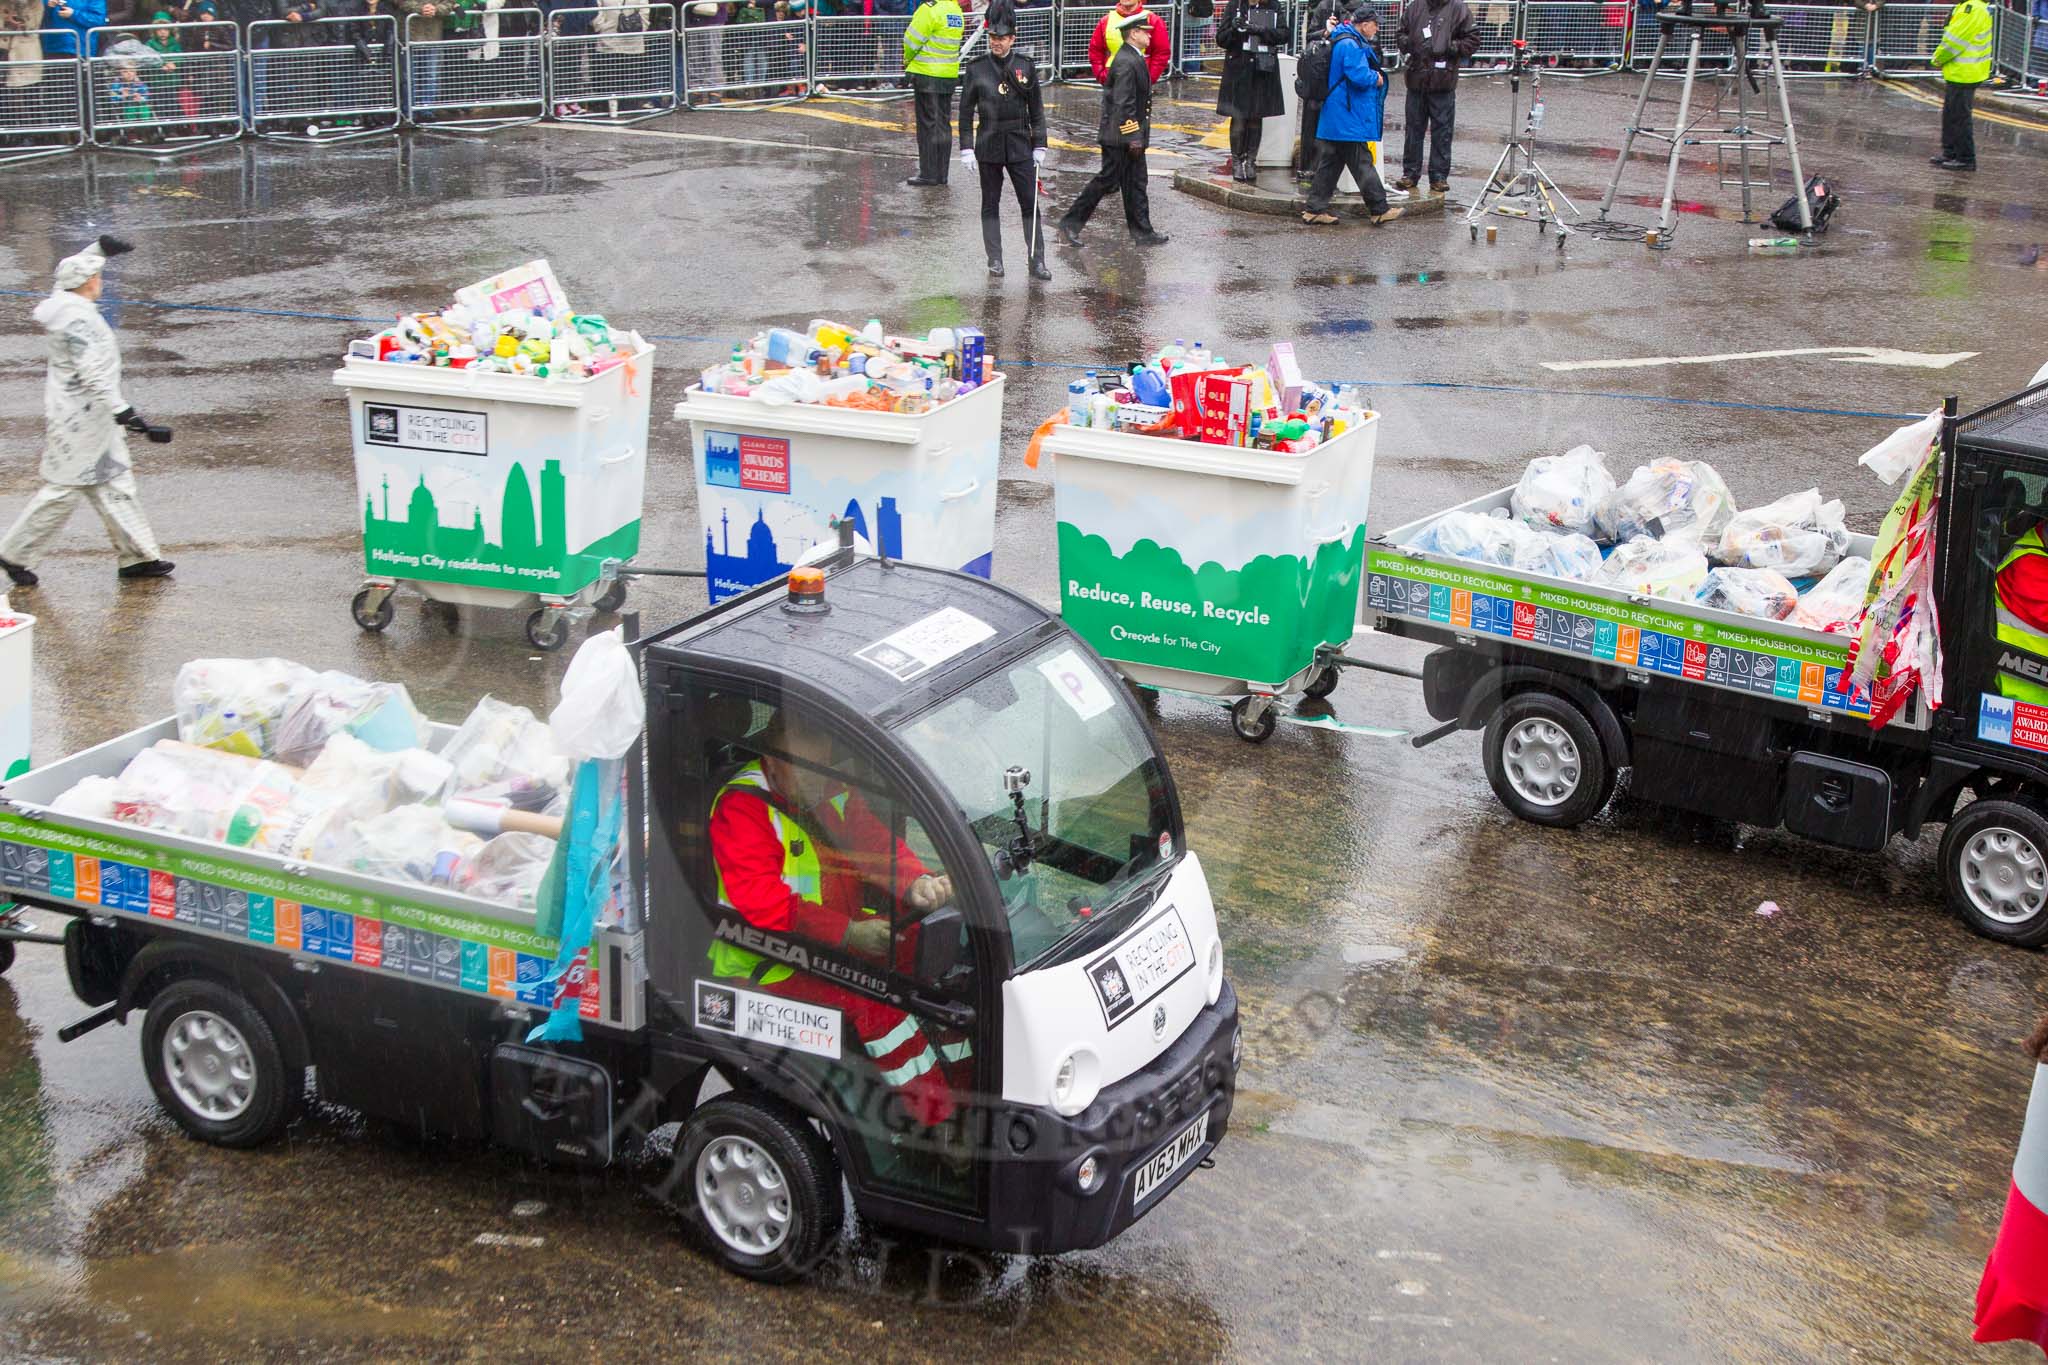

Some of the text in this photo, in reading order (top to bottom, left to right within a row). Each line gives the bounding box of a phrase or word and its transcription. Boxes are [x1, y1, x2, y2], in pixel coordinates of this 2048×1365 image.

[407, 414, 478, 432] RECYCLING
[407, 429, 480, 446] IN THE CITY
[742, 441, 785, 451] CLEAN CITY
[742, 453, 785, 469] AWARDS
[742, 468, 786, 484] SCHEME
[372, 548, 561, 580] Helping City residents to recycle
[1376, 559, 1513, 594] MIXED HOUSEHOLD RECYCLING
[1068, 580, 1271, 626] Reduce, Reuse, Recycle
[1540, 591, 1685, 632] MIXED HOUSEHOLD RECYCLING
[1127, 631, 1222, 656] recycle for The City
[1717, 629, 1848, 662] MIXED HOUSEHOLD RECYC
[2015, 716, 2048, 732] AWARD
[2017, 705, 2038, 715] CLEAN
[2014, 728, 2048, 745] SCHEM
[17, 825, 86, 848] HOUSEHOLD
[86, 838, 149, 860] RECYCLING
[181, 858, 353, 906] MIXED HOUSEHOLD RECYCLING
[390, 904, 428, 923] MIXED
[428, 912, 501, 939] HOUSEHOLD
[714, 918, 888, 993] MEGA ELECTRIC
[1125, 922, 1179, 972] RECYCLING
[1136, 943, 1185, 991] IN THE CITY
[747, 999, 829, 1030] RECYCLING
[747, 1017, 763, 1033] IN
[767, 1020, 796, 1040] THE
[799, 1029, 834, 1049] CITY
[1136, 1117, 1204, 1198] AV63 MHX
